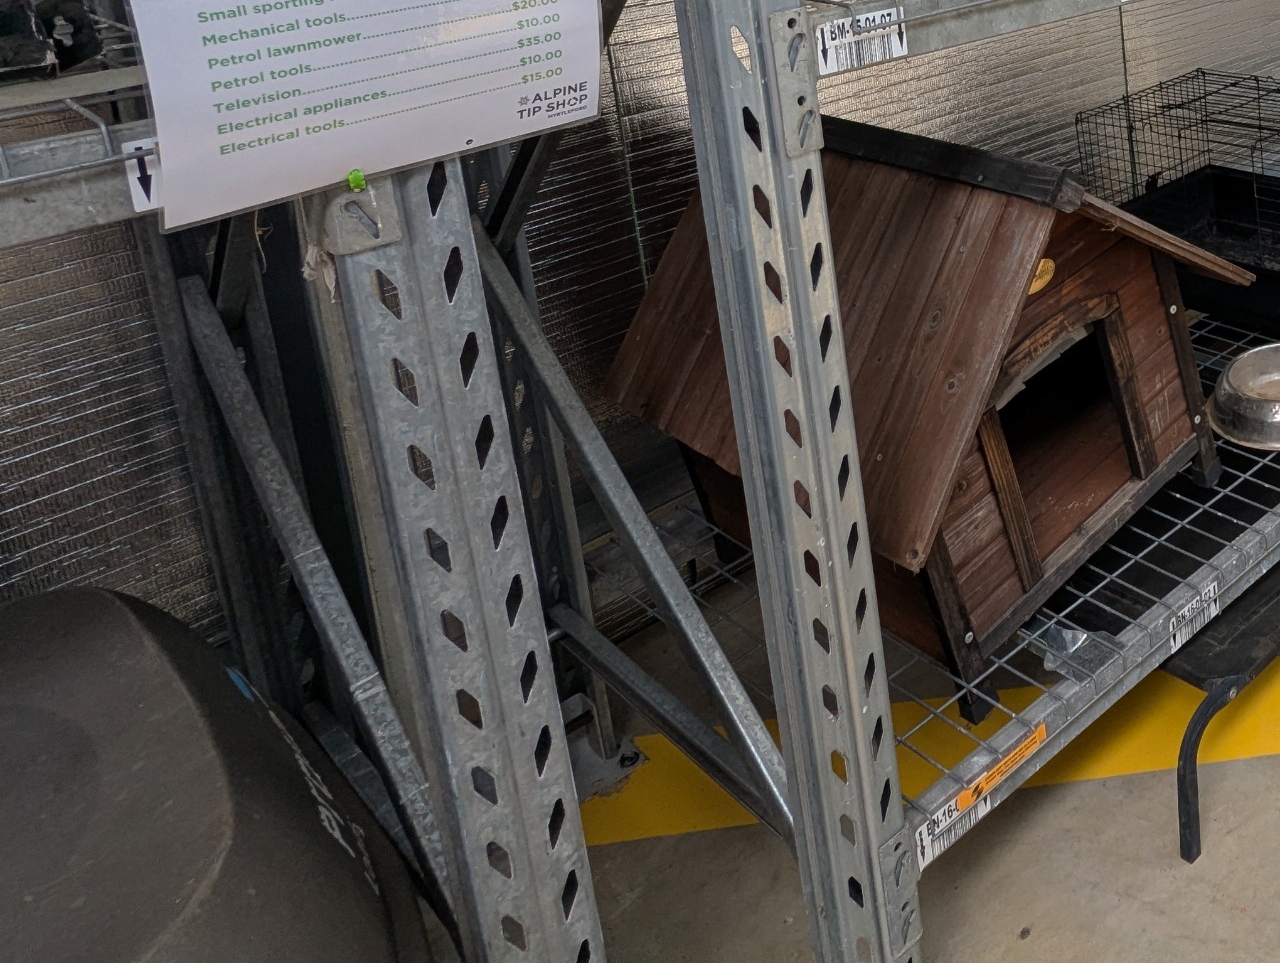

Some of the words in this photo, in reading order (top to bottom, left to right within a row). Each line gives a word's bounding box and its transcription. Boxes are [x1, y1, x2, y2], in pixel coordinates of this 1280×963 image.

[197, 5, 248, 24] Small
[202, 19, 301, 47] Mechanical
[517, 31, 562, 50] $35.00
[207, 49, 262, 69] Petrol
[211, 72, 265, 92] Petrol
[516, 13, 560, 30] $10.00
[217, 108, 298, 135] Electrical
[519, 49, 563, 67] $10.00
[531, 81, 588, 104] ALPINE
[219, 128, 300, 155] Electrical
[521, 67, 563, 85] $15.00
[516, 106, 542, 120] TIP
[545, 94, 588, 112] SHOP
[547, 105, 588, 119] MYRTLEFORD
